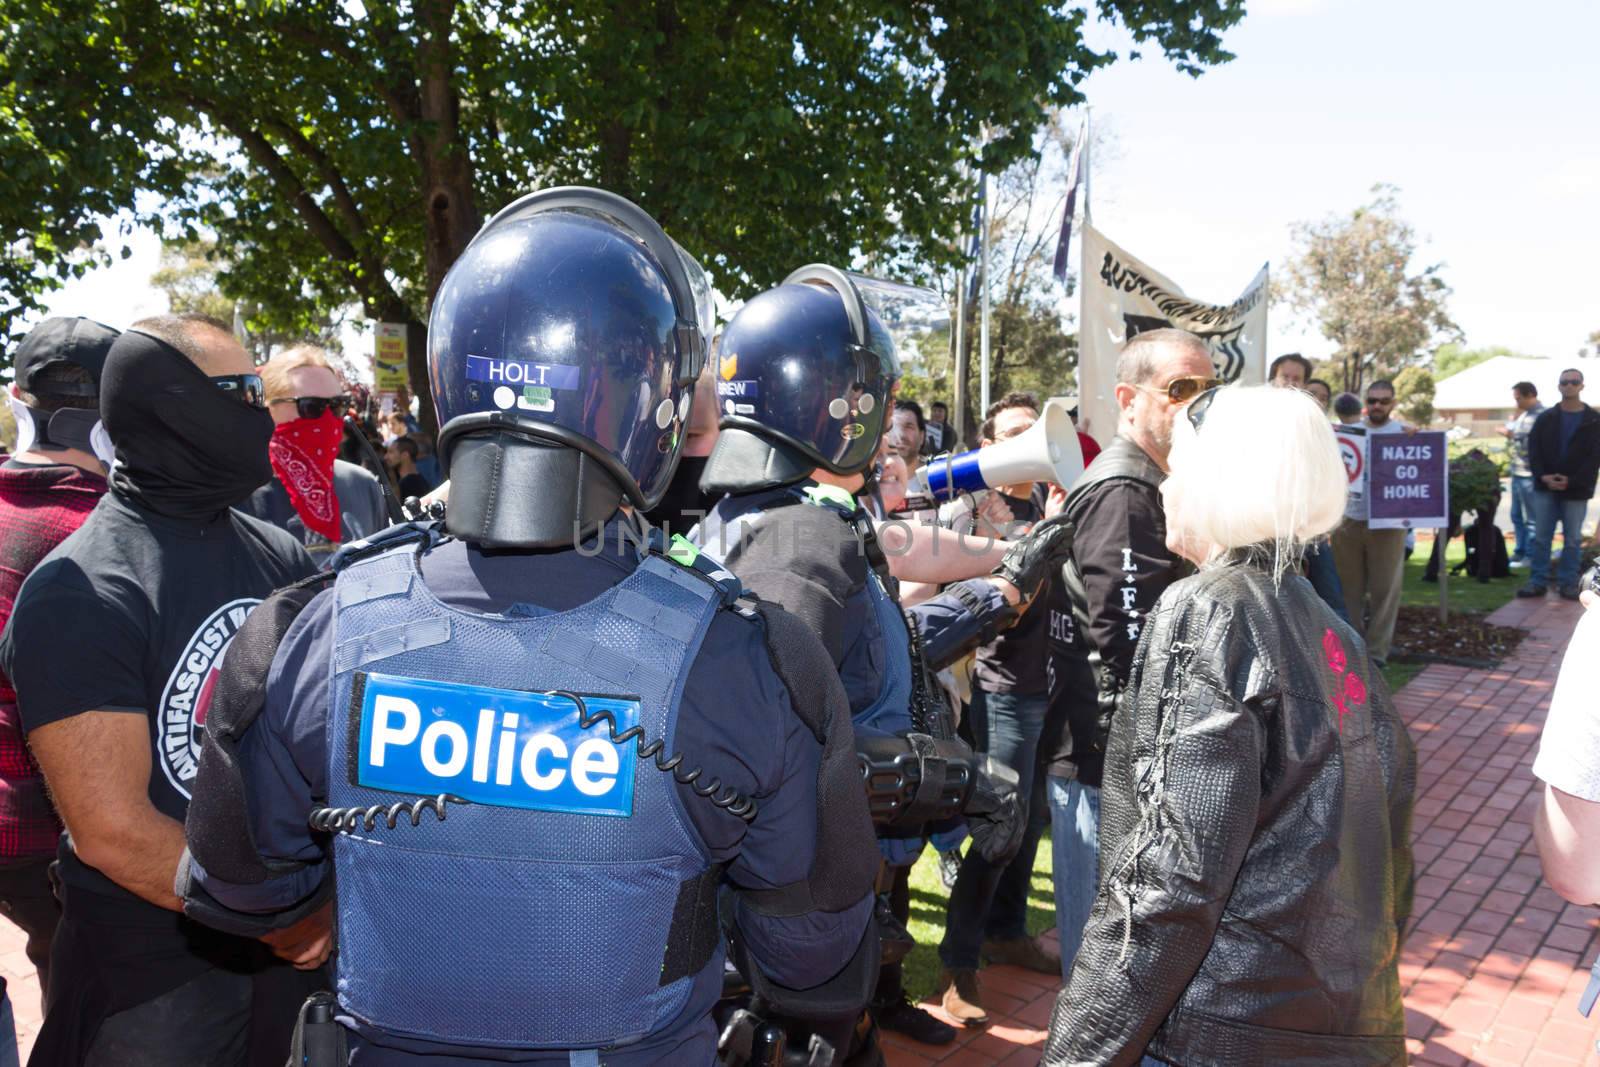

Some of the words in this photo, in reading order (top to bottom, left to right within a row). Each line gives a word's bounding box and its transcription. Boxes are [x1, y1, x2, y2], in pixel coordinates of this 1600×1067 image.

[488, 361, 551, 385] HOLT
[1381, 445, 1432, 460] NAZIS
[1395, 465, 1418, 480] GO
[1383, 484, 1431, 499] HOME
[165, 615, 231, 781] ANTIFASCIST
[369, 694, 620, 796] Police
